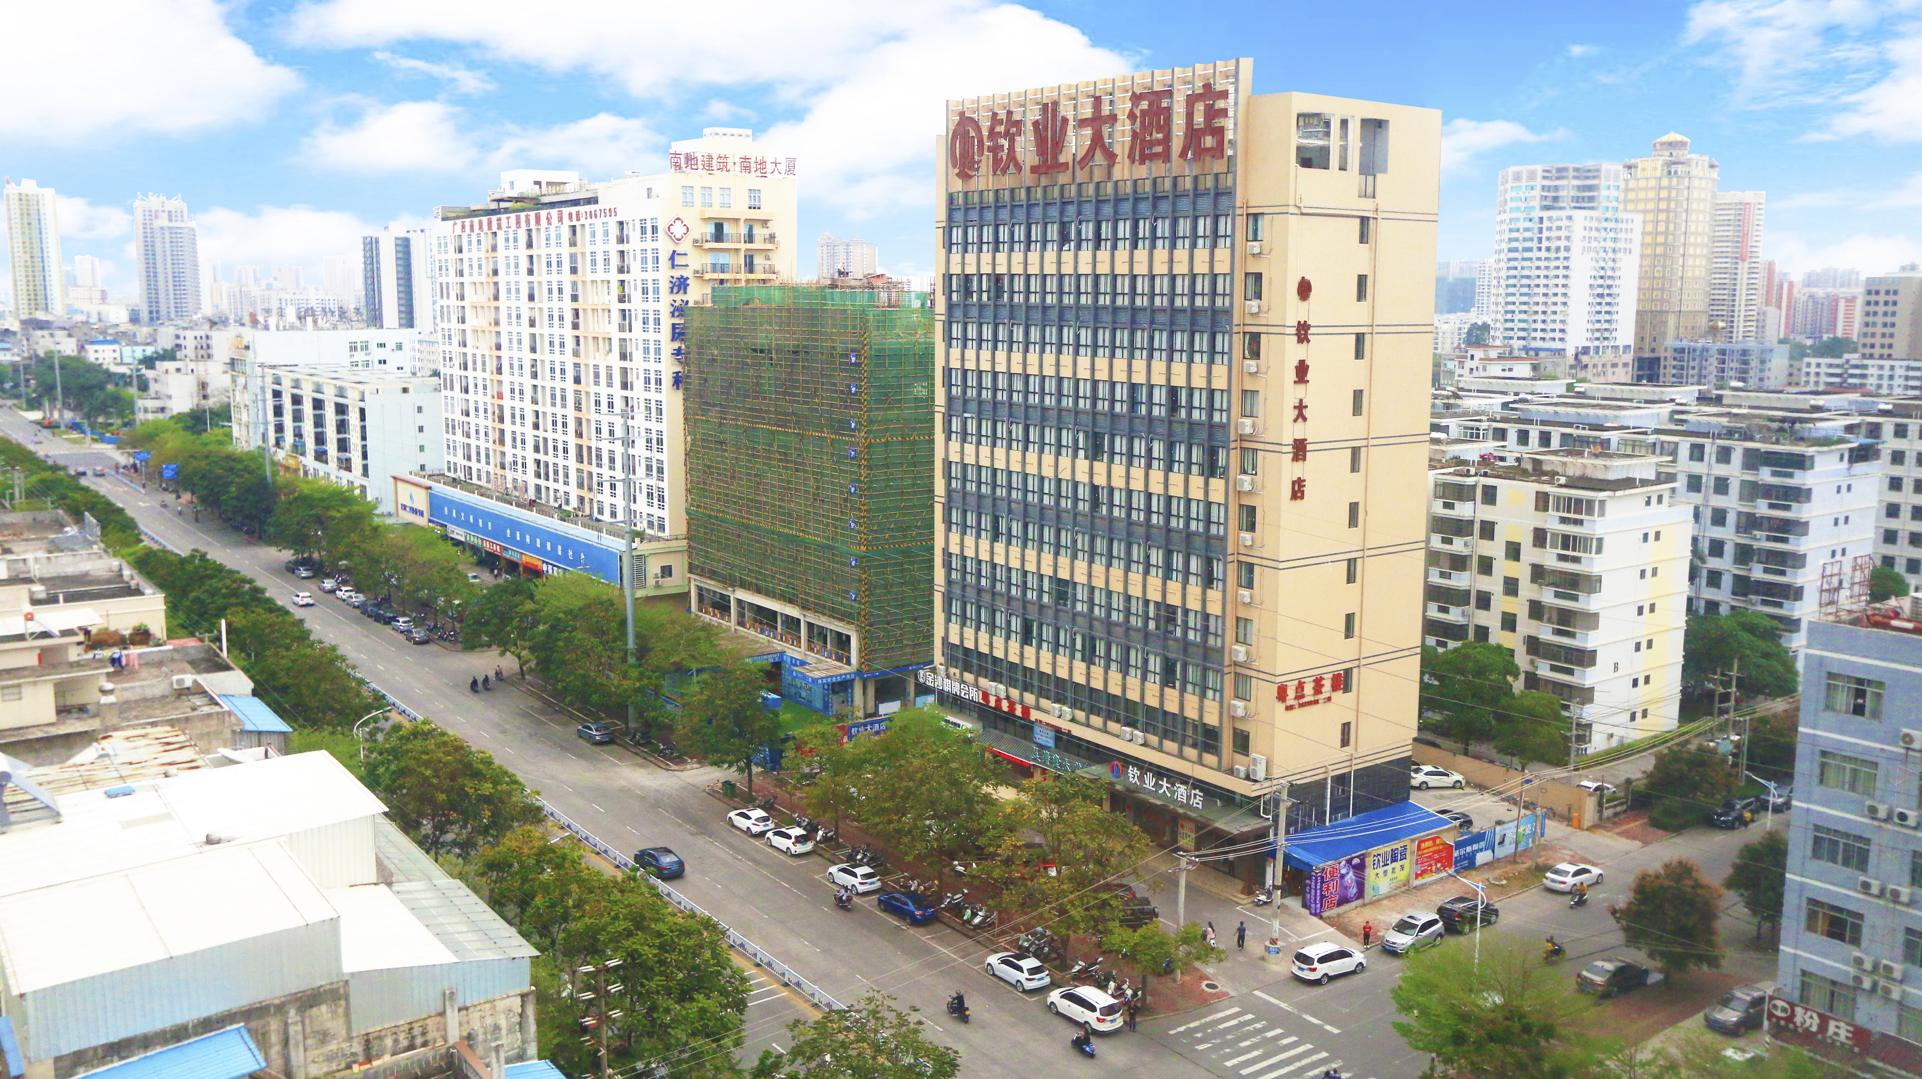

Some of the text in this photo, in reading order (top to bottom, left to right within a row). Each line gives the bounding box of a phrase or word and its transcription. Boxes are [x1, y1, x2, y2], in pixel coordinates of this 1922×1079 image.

[986, 82, 1229, 176] 钦业大酒店
[1290, 320, 1311, 501] 钦业大酒店
[925, 671, 979, 703] 金沙棋牌会所
[1127, 764, 1204, 810] 钦业大酒店
[1372, 844, 1408, 870] 钦业陶瓷
[1322, 863, 1340, 911] 便利店
[1792, 1005, 1855, 1045] 粉庄
